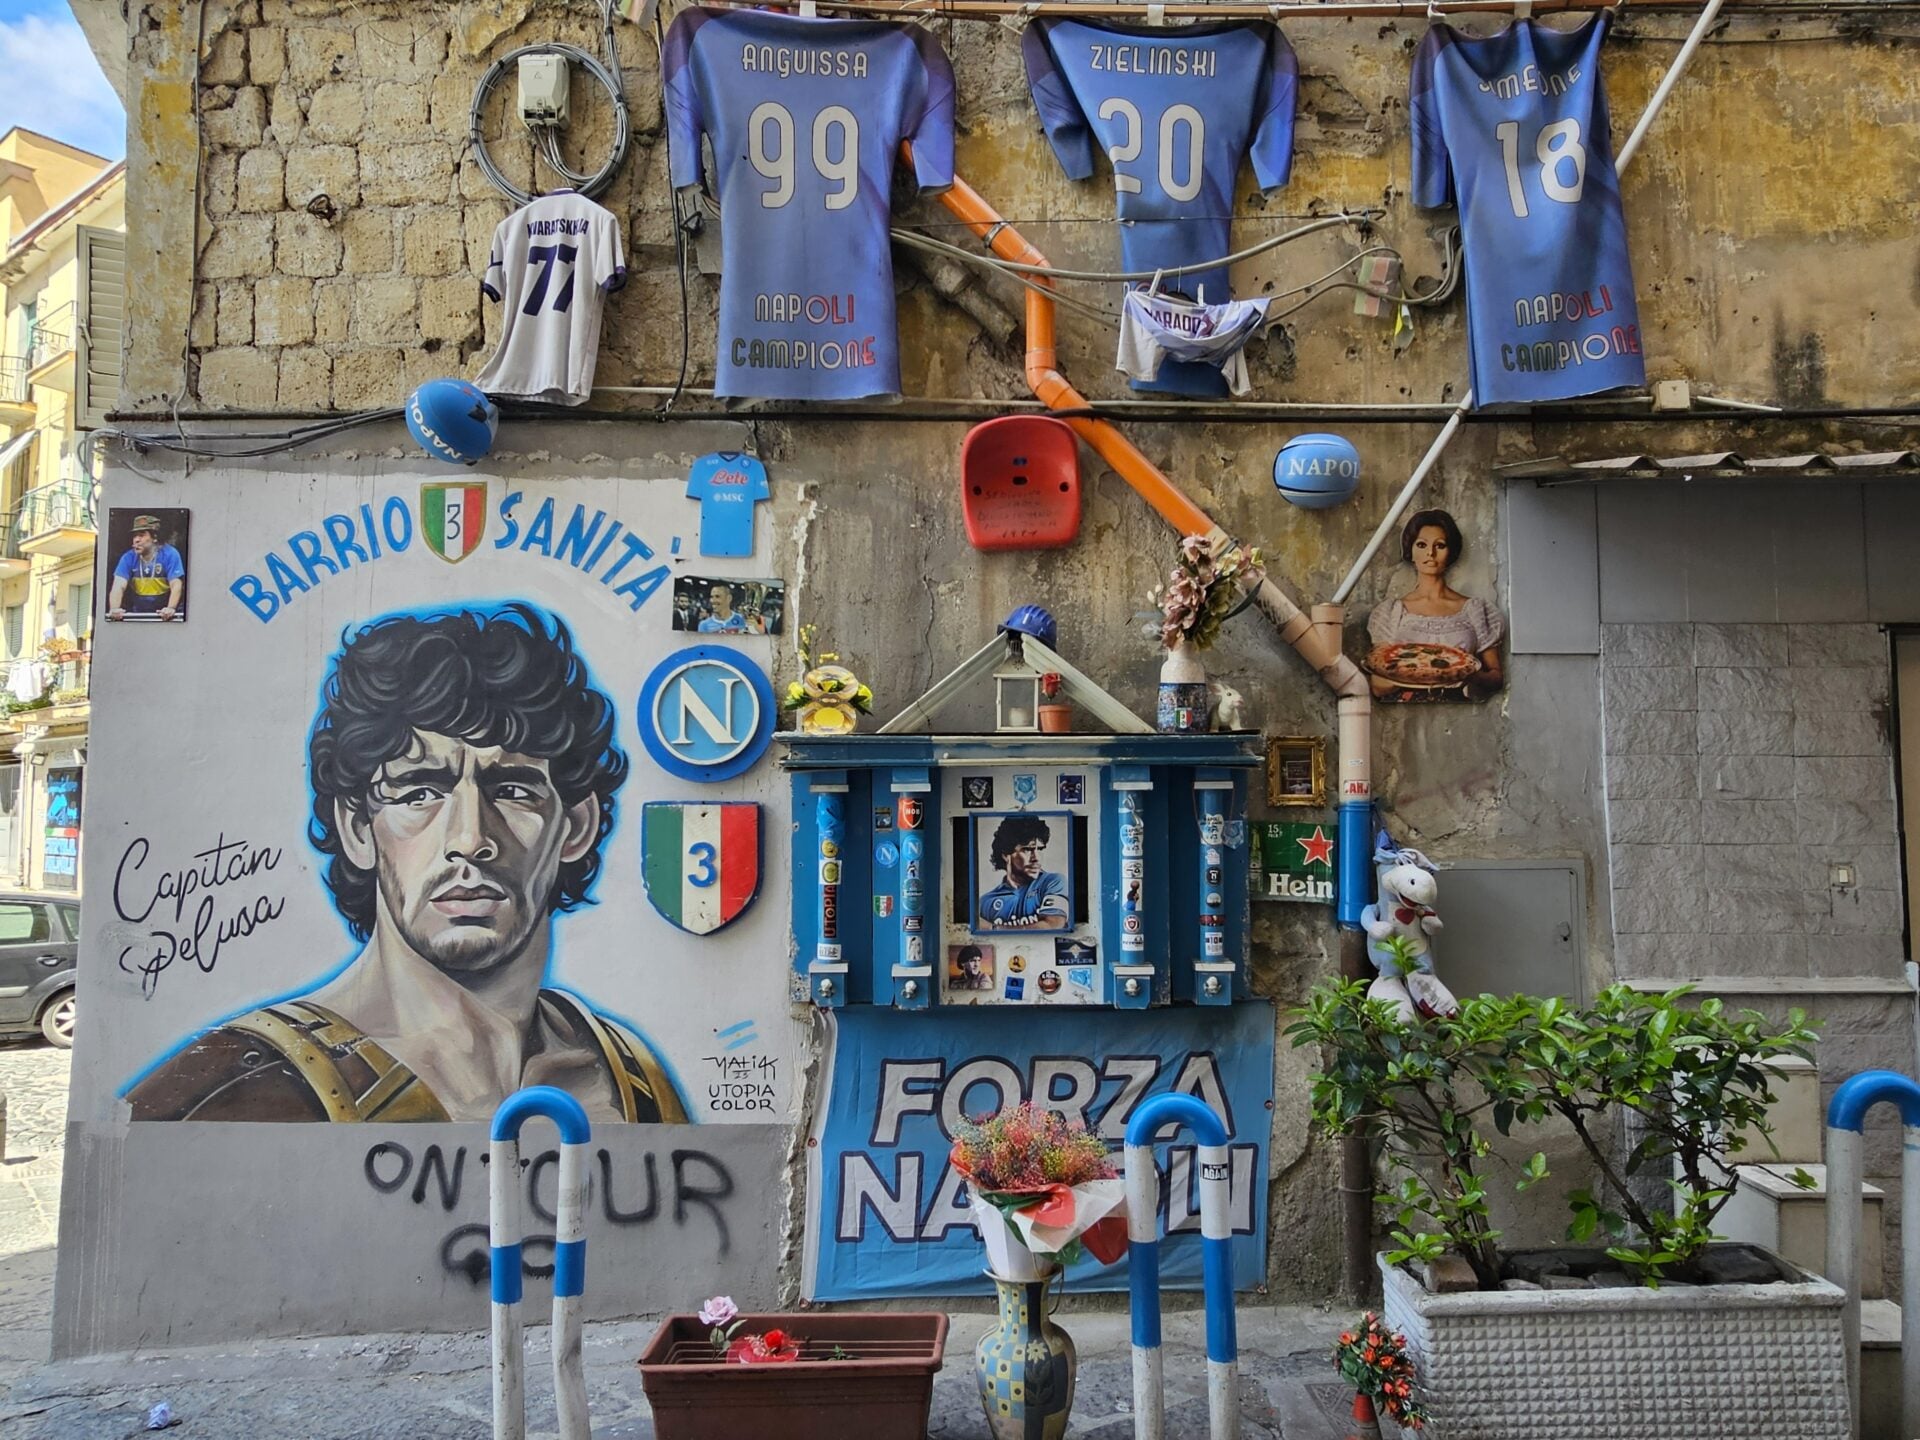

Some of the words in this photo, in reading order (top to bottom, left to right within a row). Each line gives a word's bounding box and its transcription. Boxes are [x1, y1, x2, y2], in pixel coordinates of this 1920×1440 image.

[742, 44, 869, 78] ANGUISSA
[1089, 45, 1216, 77] ZIELINSKI
[748, 102, 860, 210] 99
[1099, 98, 1206, 202] 20
[1496, 117, 1586, 218] 18
[522, 243, 579, 316] 77
[754, 294, 855, 325] NAPOLI
[1515, 285, 1610, 328] NAPOLI
[731, 336, 877, 370] CAMPIONE
[1501, 325, 1640, 373] CAMPIONE
[710, 468, 749, 485] Lete
[446, 503, 462, 541] 3
[229, 496, 413, 624] BARRIO
[671, 676, 742, 745] N
[1268, 824, 1279, 834] 15
[113, 832, 282, 923] Capitán
[687, 841, 718, 888] 3
[1268, 873, 1334, 898] Hein
[708, 1083, 776, 1098] UTOPIA
[710, 1098, 777, 1115] COLOR
[869, 1052, 1236, 1147] FORZA
[364, 1141, 468, 1213] ON
[479, 1147, 736, 1258] OUR
[835, 1143, 1259, 1243] NALI
